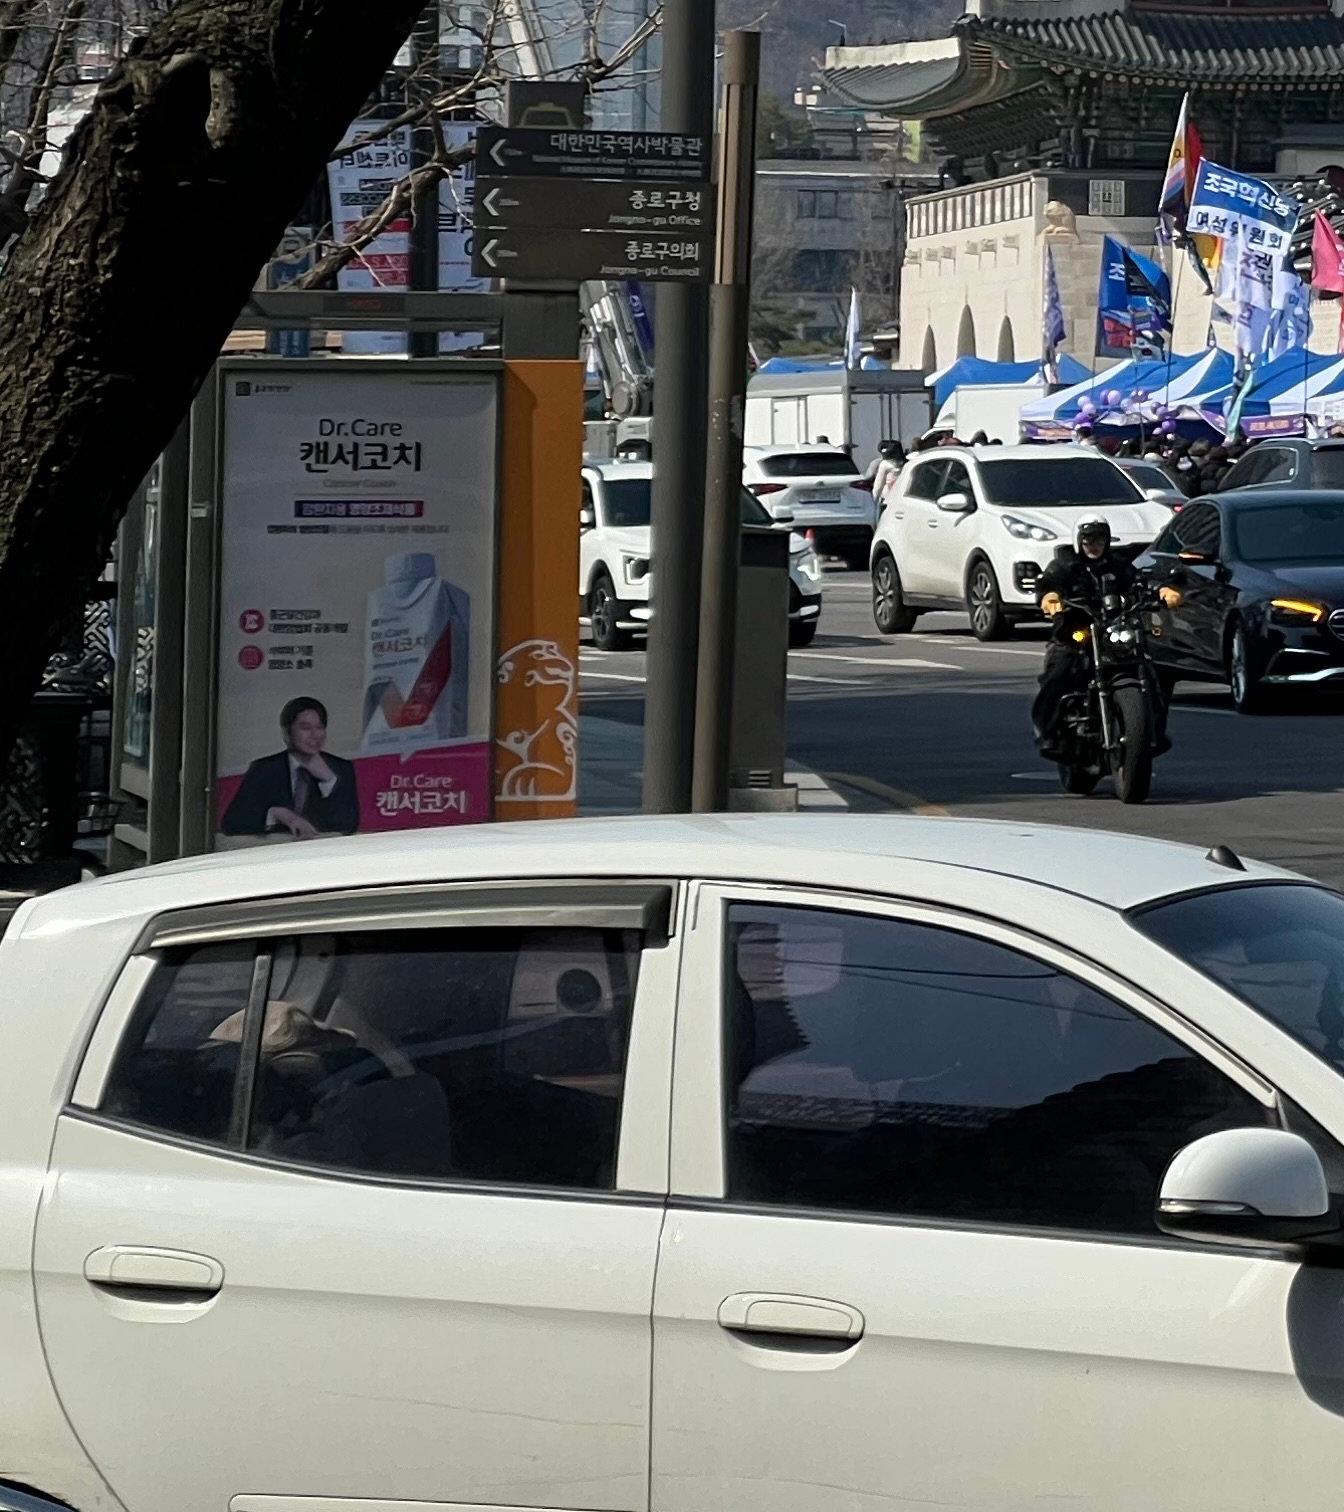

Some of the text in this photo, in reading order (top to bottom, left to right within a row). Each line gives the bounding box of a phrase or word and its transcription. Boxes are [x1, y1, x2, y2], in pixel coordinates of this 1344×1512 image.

[550, 133, 703, 156] 대한민국역사박물관
[628, 190, 701, 211] 종로구청
[1203, 172, 1290, 217] 조국혁신당
[624, 240, 699, 261] 종로구의회
[319, 418, 403, 438] Dr.Care
[300, 441, 422, 473] 캔서코치
[390, 774, 453, 788] Dr.Care
[376, 791, 466, 816] 캔서코치
